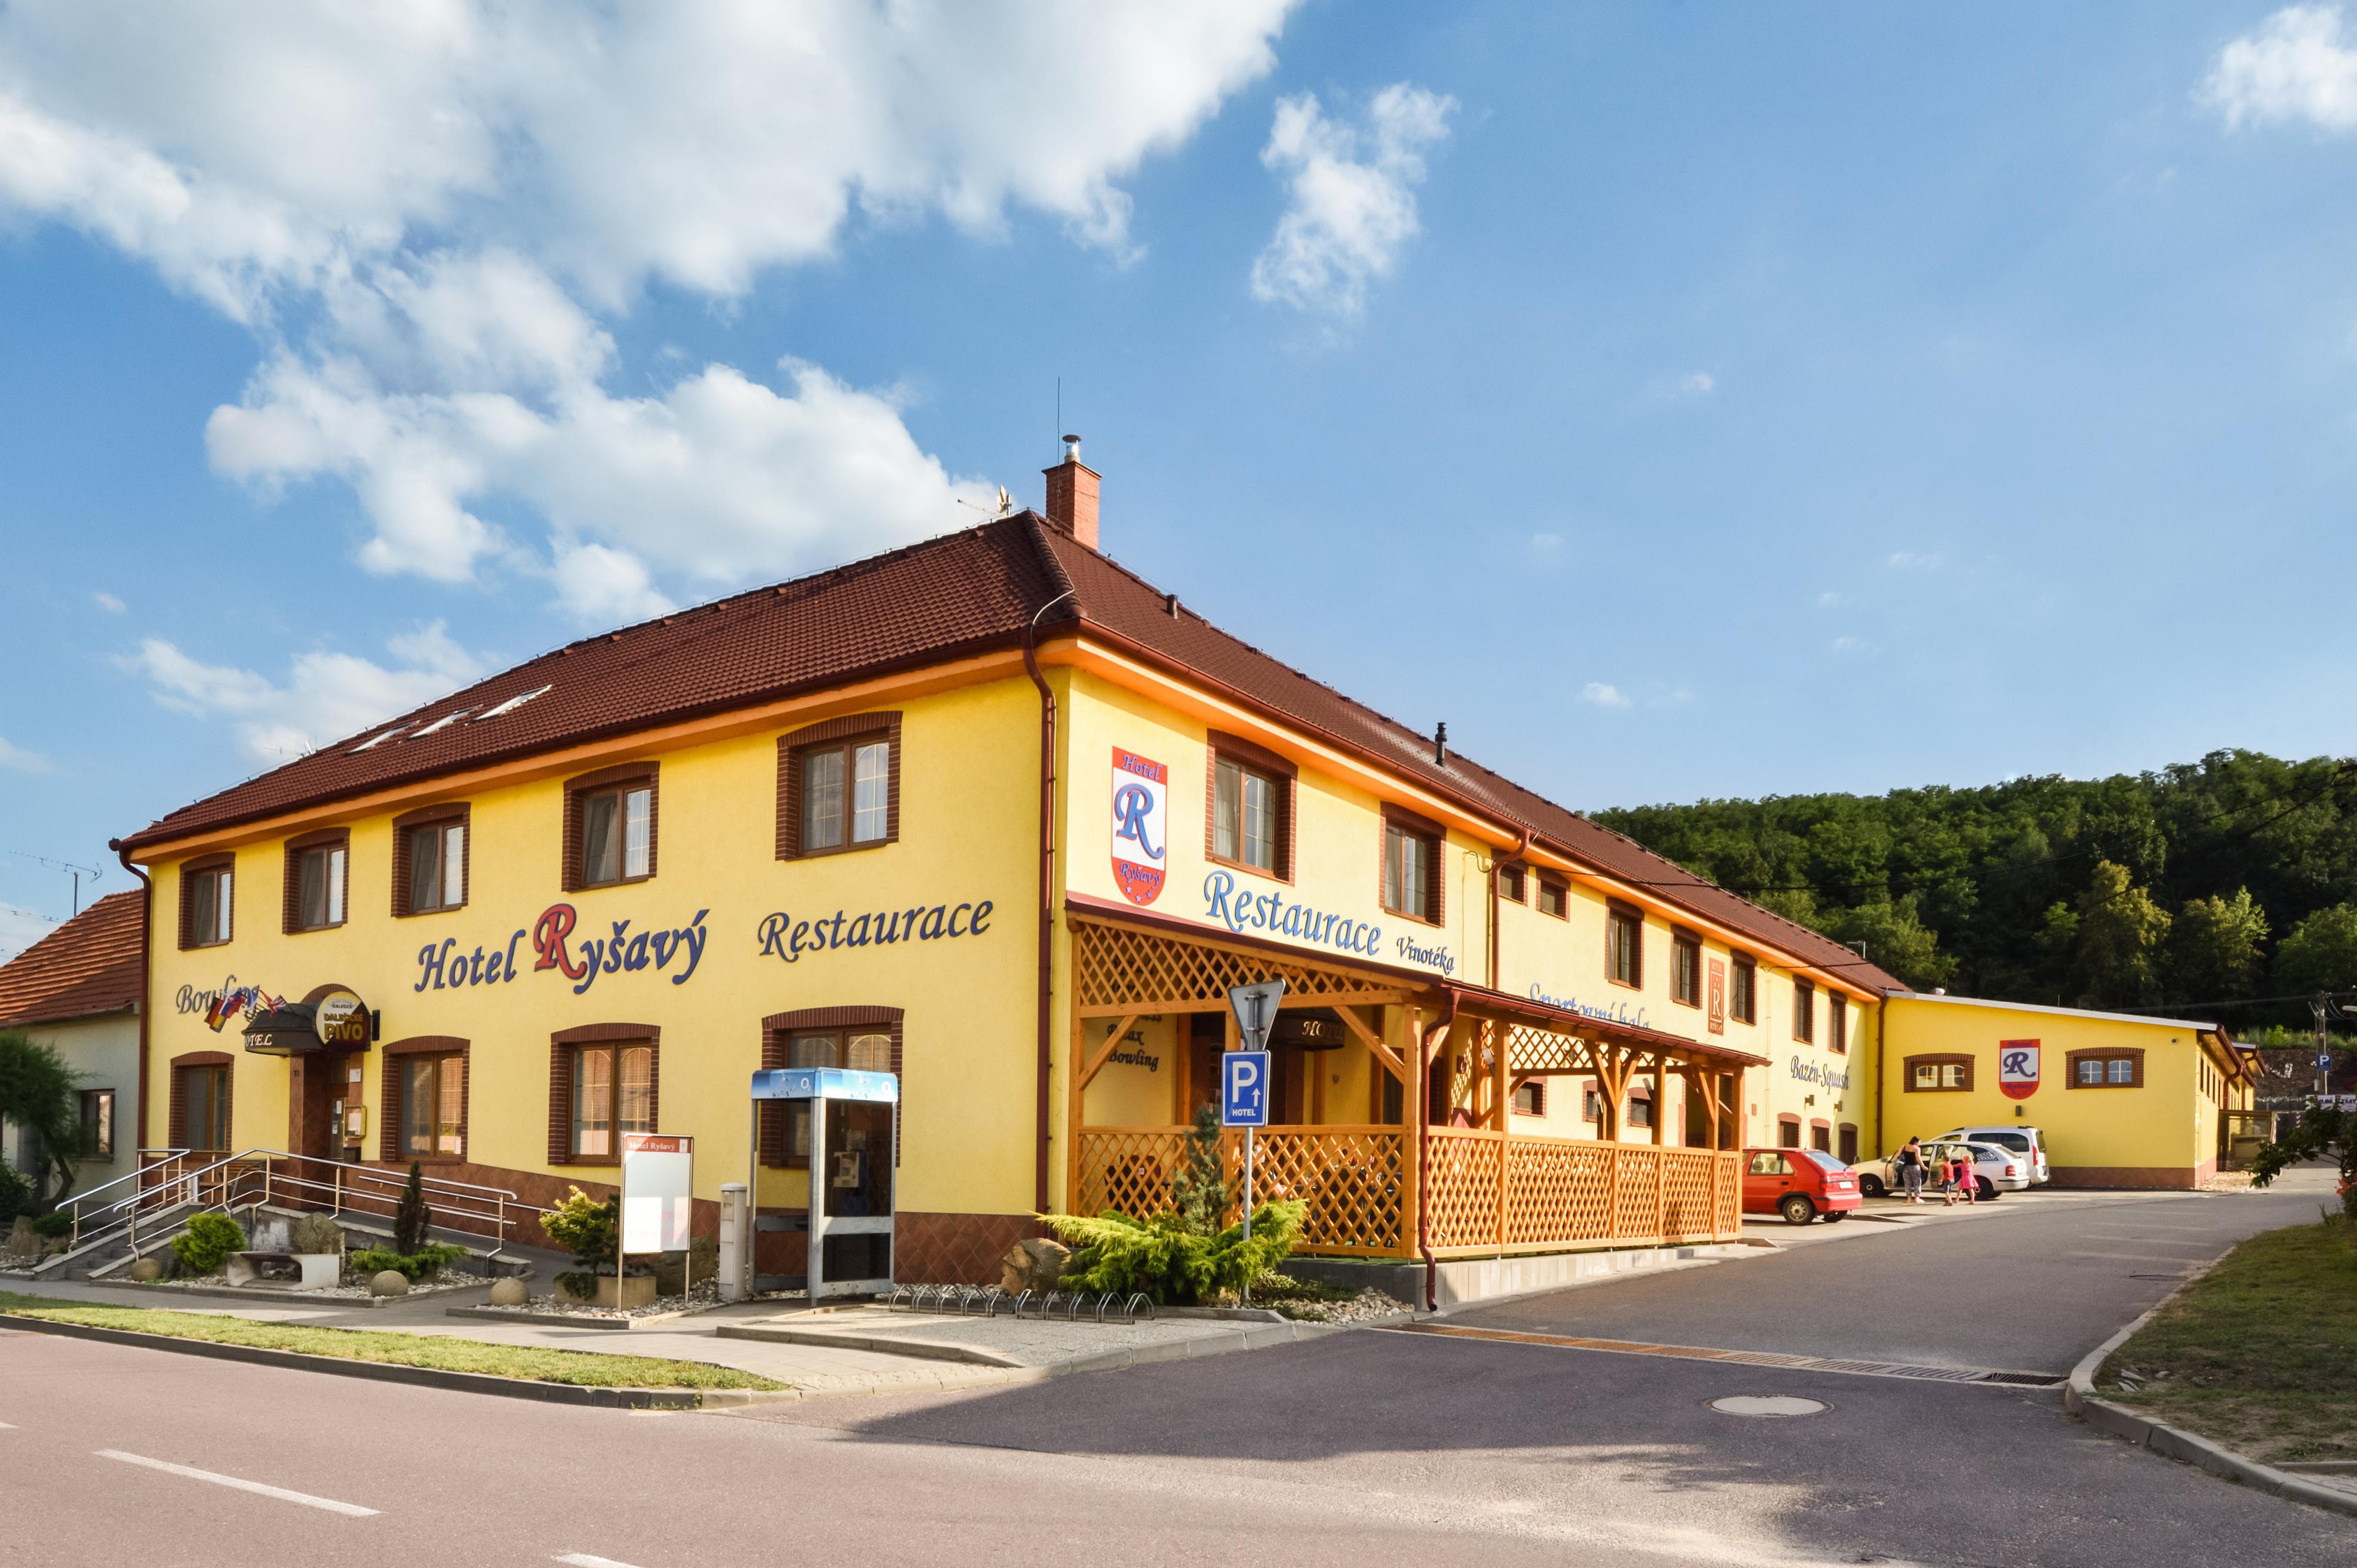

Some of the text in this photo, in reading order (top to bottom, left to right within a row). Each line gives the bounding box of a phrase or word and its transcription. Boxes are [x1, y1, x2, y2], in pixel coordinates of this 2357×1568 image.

[1122, 754, 1163, 780] Hotel
[1114, 783, 1164, 860] R
[1120, 863, 1160, 890] Ryšavý
[1204, 870, 1381, 956] Restaurace
[758, 900, 993, 962] Restaurace
[414, 903, 709, 995] Hotel Ryšavý
[1397, 936, 1455, 976] Vinotéka
[176, 975, 260, 1021] Bowl
[1712, 989, 1721, 1017] R
[324, 1023, 363, 1041] PIVO
[1107, 1024, 1144, 1045] Rax
[1791, 1055, 1849, 1095] Bazén-Squash
[2003, 1052, 2036, 1078] R
[2319, 1055, 2329, 1065] P
[1232, 1061, 1257, 1103] P
[651, 1142, 675, 1151] Ryšavý
